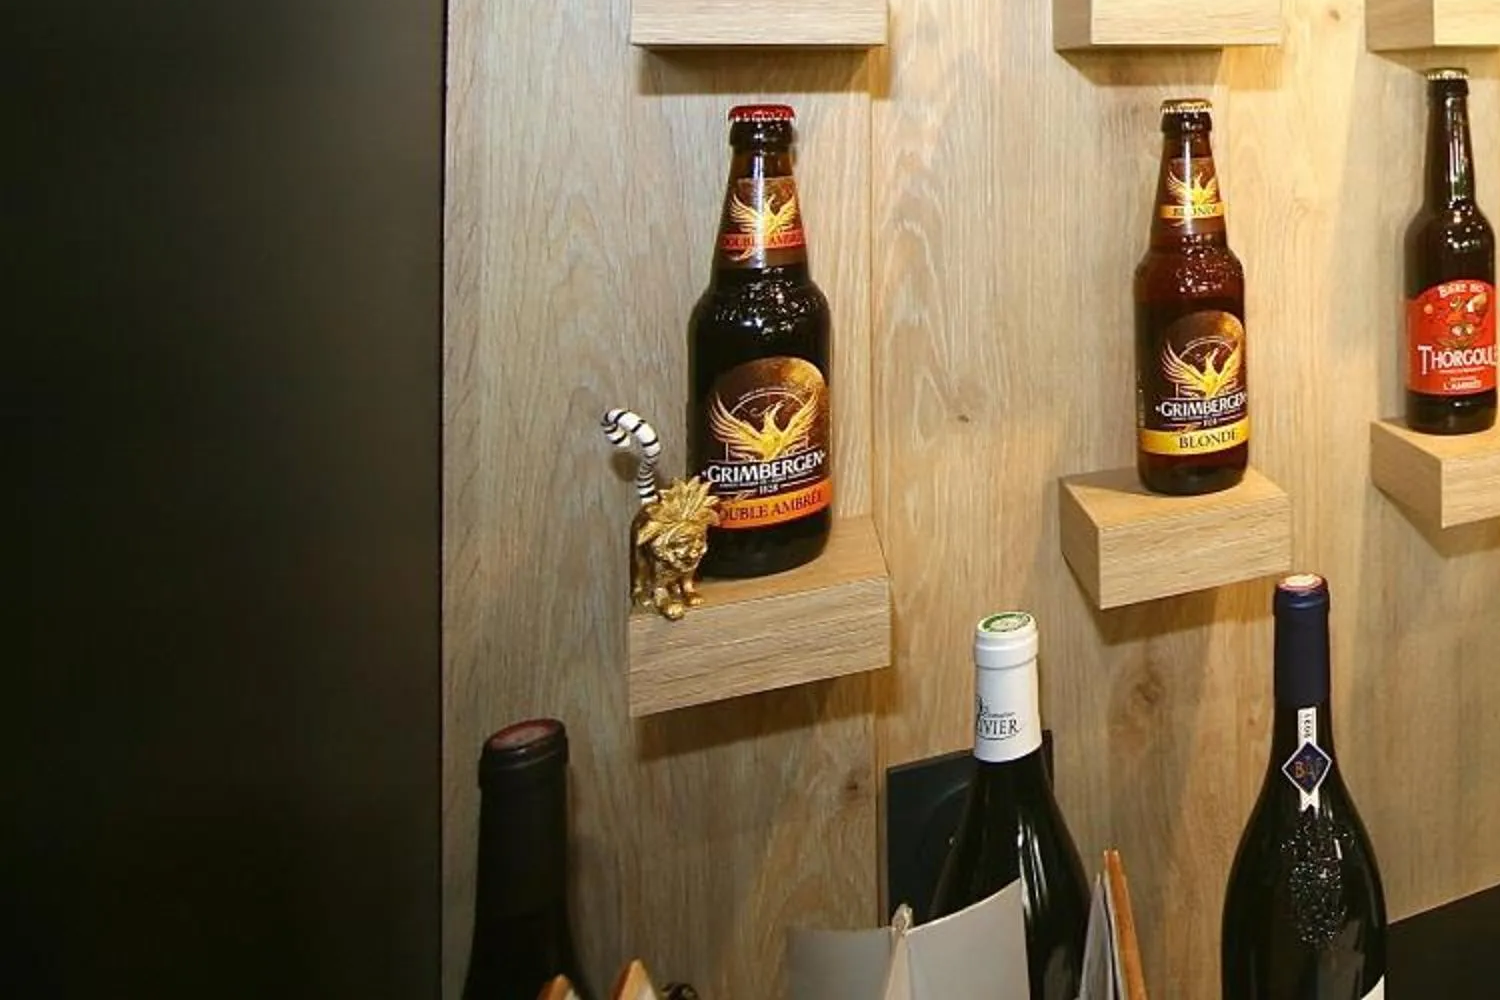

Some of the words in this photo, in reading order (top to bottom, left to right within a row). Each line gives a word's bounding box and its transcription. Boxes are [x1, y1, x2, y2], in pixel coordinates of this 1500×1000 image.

[1160, 393, 1247, 418] GRIMBERGEN
[1179, 428, 1237, 449] BLONDE
[707, 452, 824, 485] GRIMBERGEN
[718, 506, 769, 522] OUBLE
